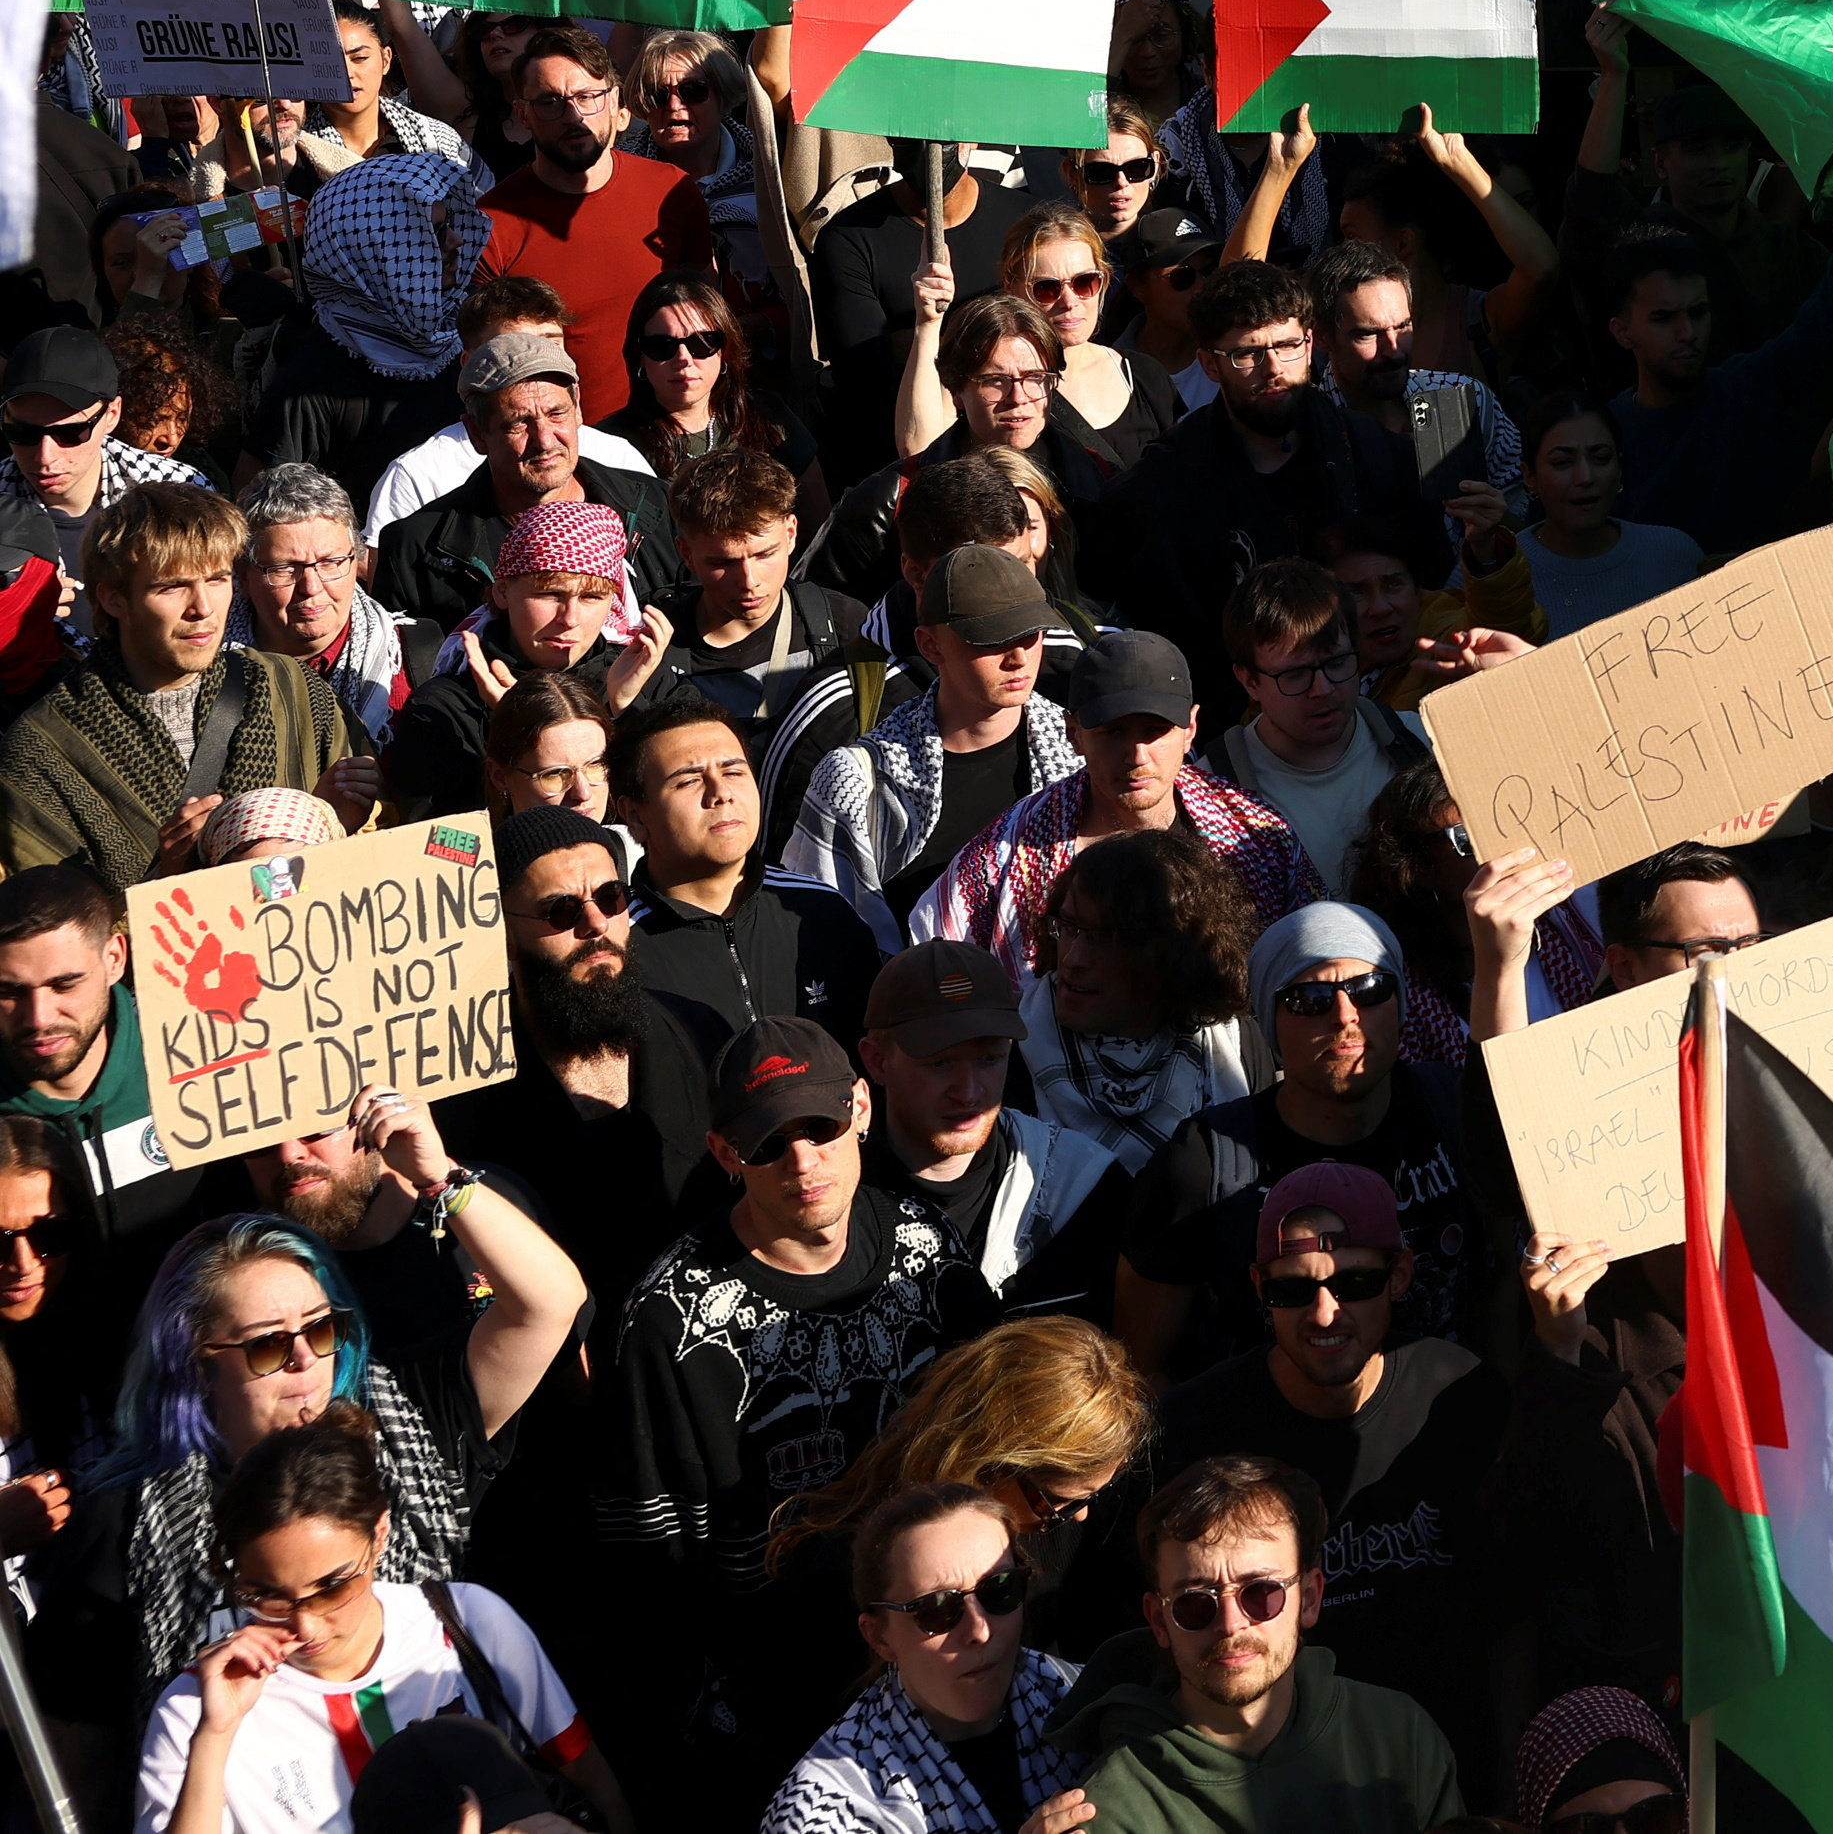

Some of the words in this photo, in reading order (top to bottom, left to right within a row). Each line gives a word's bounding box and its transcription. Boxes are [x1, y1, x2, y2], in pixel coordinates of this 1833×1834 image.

[136, 13, 222, 58] GRÜNE
[224, 20, 302, 61] RAUS!
[1175, 228, 1203, 238] adidas
[1581, 579, 1775, 705] FREE
[427, 843, 479, 868] PALESTINE
[434, 826, 480, 854] FREE
[254, 858, 502, 993] BOMBING
[161, 997, 271, 1079] KIDS
[302, 977, 343, 1034] IS
[372, 940, 465, 1014] NOT
[807, 995, 829, 1005] adidas
